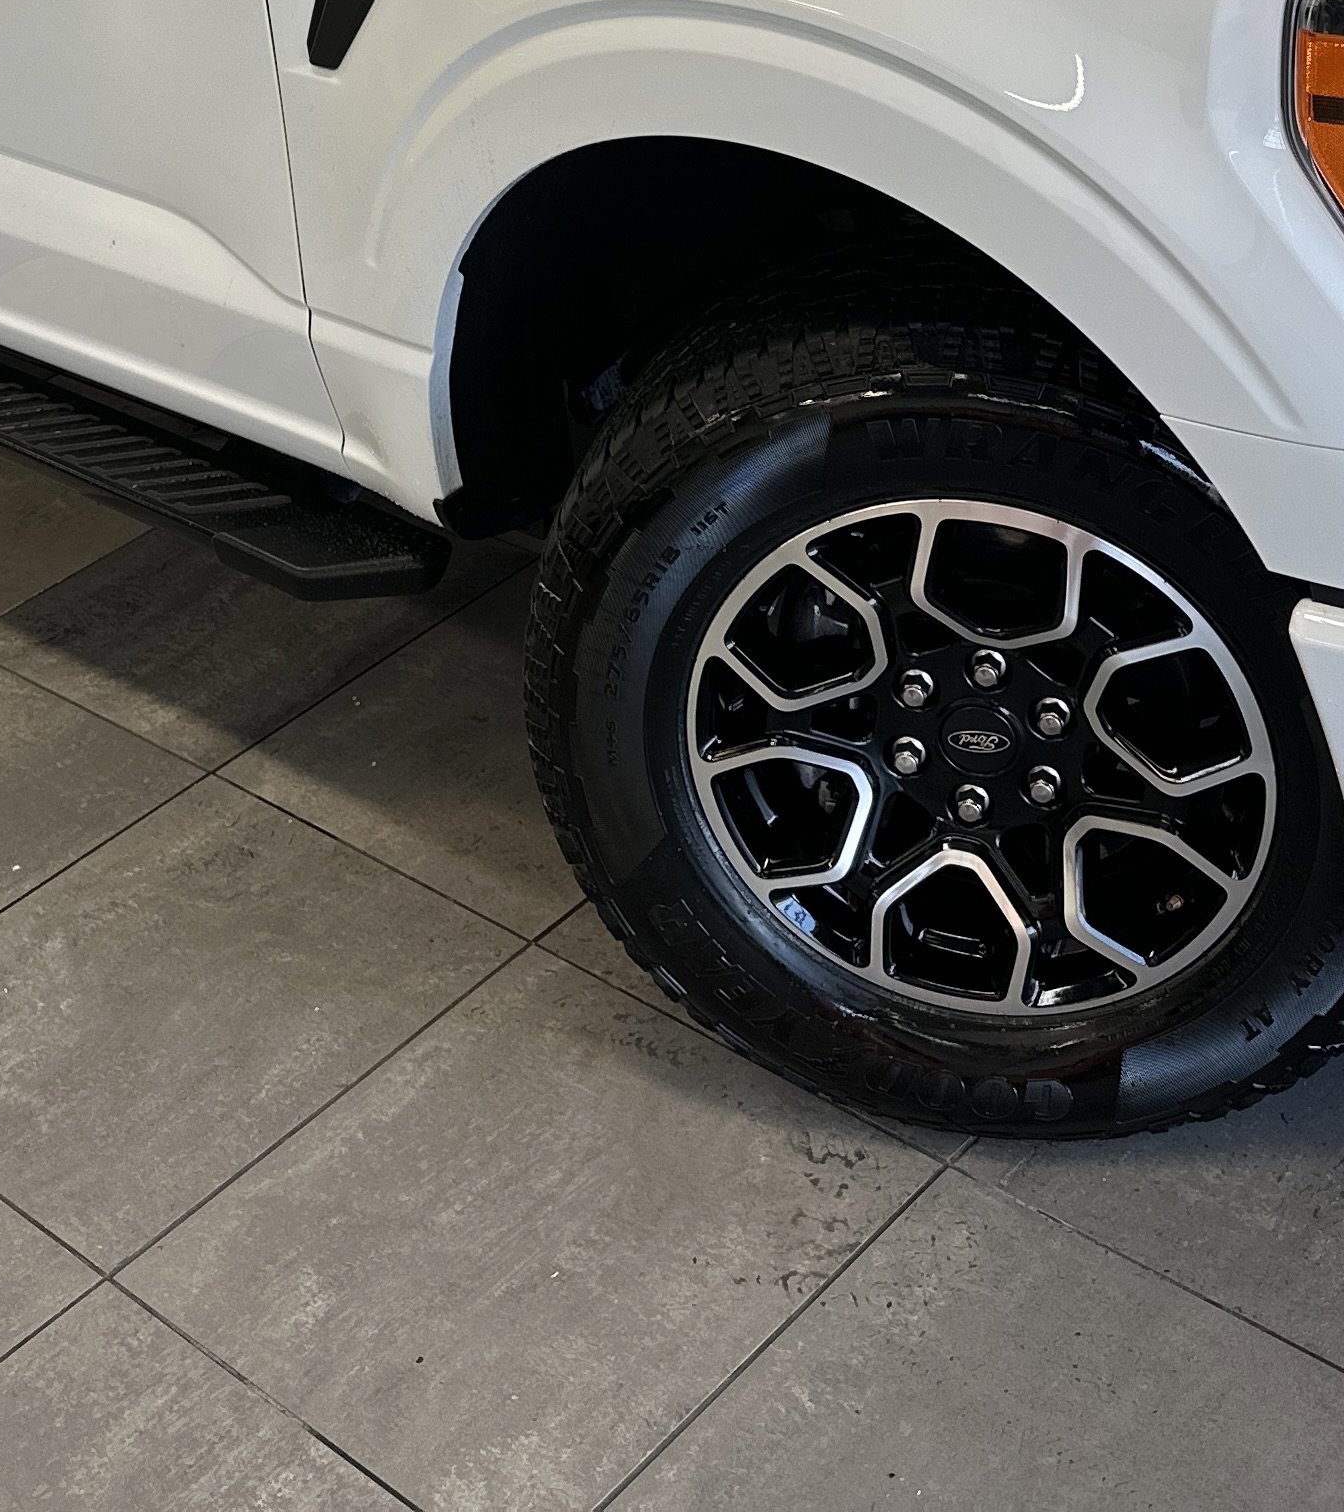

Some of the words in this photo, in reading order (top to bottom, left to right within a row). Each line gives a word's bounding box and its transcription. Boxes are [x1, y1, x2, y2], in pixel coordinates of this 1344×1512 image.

[690, 501, 729, 536] 116T
[865, 417, 1294, 603] WRANGL
[959, 733, 999, 751] Ford
[647, 897, 1075, 1122] GOODYEAR
